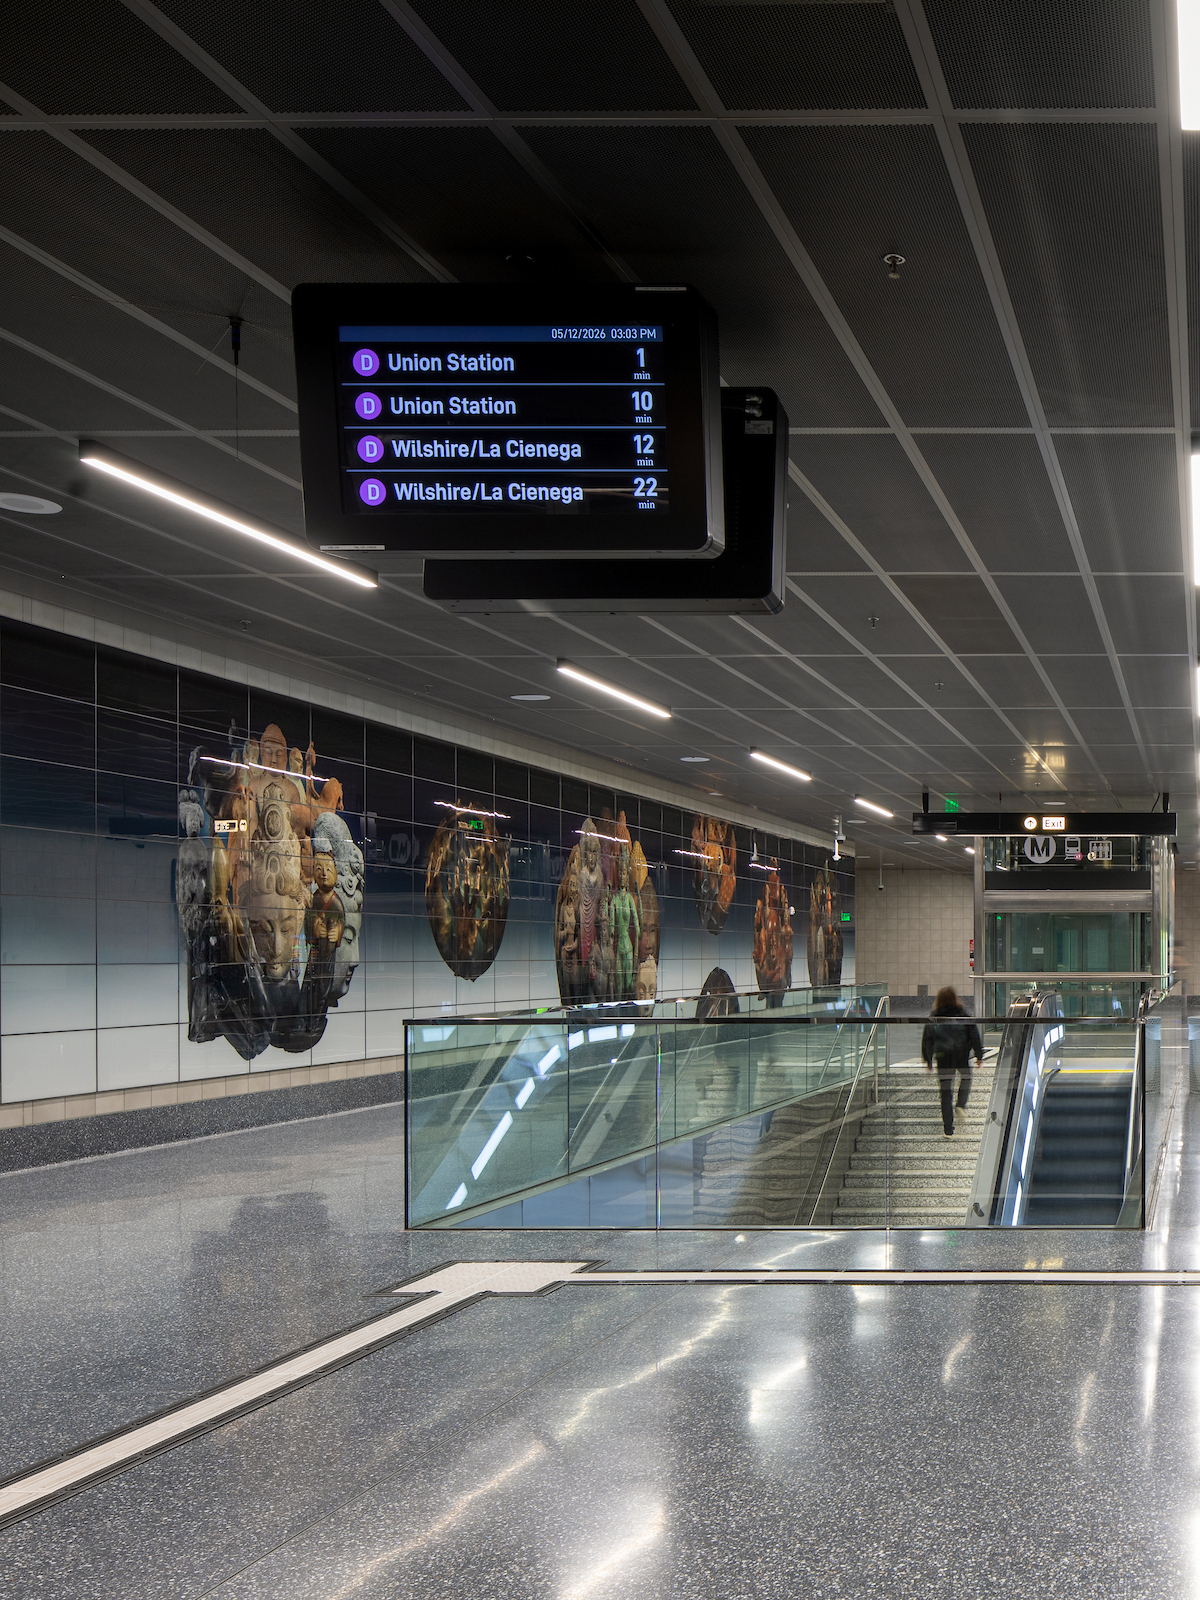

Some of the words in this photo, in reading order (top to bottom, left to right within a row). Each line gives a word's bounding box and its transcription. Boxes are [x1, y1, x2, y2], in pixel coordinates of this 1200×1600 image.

[551, 328, 606, 339] 05/12/2026
[611, 328, 637, 339] 03:03
[640, 329, 657, 339] PM
[361, 354, 373, 371] D
[388, 353, 442, 371] Union
[447, 353, 515, 372] Station
[636, 347, 645, 368] 1
[633, 370, 651, 380] min
[363, 398, 376, 415] D
[390, 396, 444, 415] Union
[449, 396, 517, 415] Station
[631, 391, 653, 411] 10
[635, 413, 653, 423] min
[365, 441, 378, 458] D
[391, 439, 501, 458] Wilshire/La
[506, 439, 582, 462] Cienega
[633, 434, 655, 454] 12
[636, 456, 654, 466] min
[367, 484, 380, 501] D
[393, 482, 503, 501] Wilshire/La
[508, 482, 584, 505] Cienega
[633, 477, 658, 497] 22
[638, 499, 656, 509] min
[1045, 819, 1063, 828] Exit
